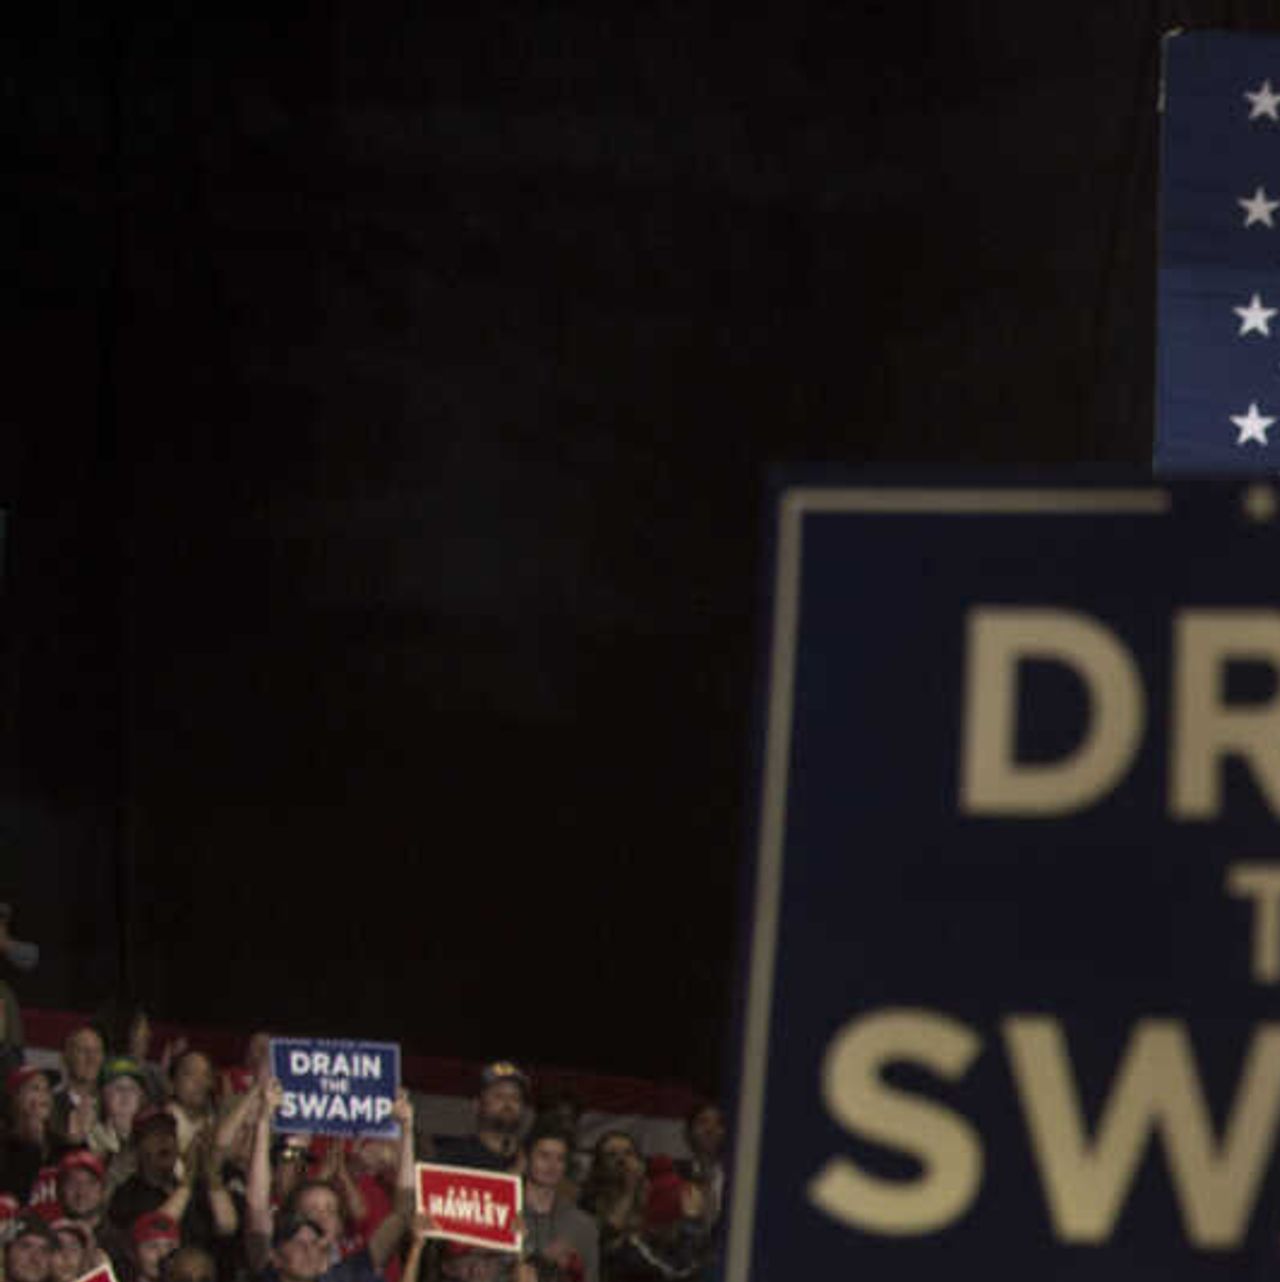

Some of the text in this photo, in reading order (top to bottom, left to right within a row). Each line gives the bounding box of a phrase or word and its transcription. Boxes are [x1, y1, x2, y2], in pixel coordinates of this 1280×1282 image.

[290, 1051, 381, 1079] DRAIN
[320, 1076, 348, 1092] THE
[280, 1091, 393, 1123] SWAMP
[428, 1191, 510, 1228] HAWLEY
